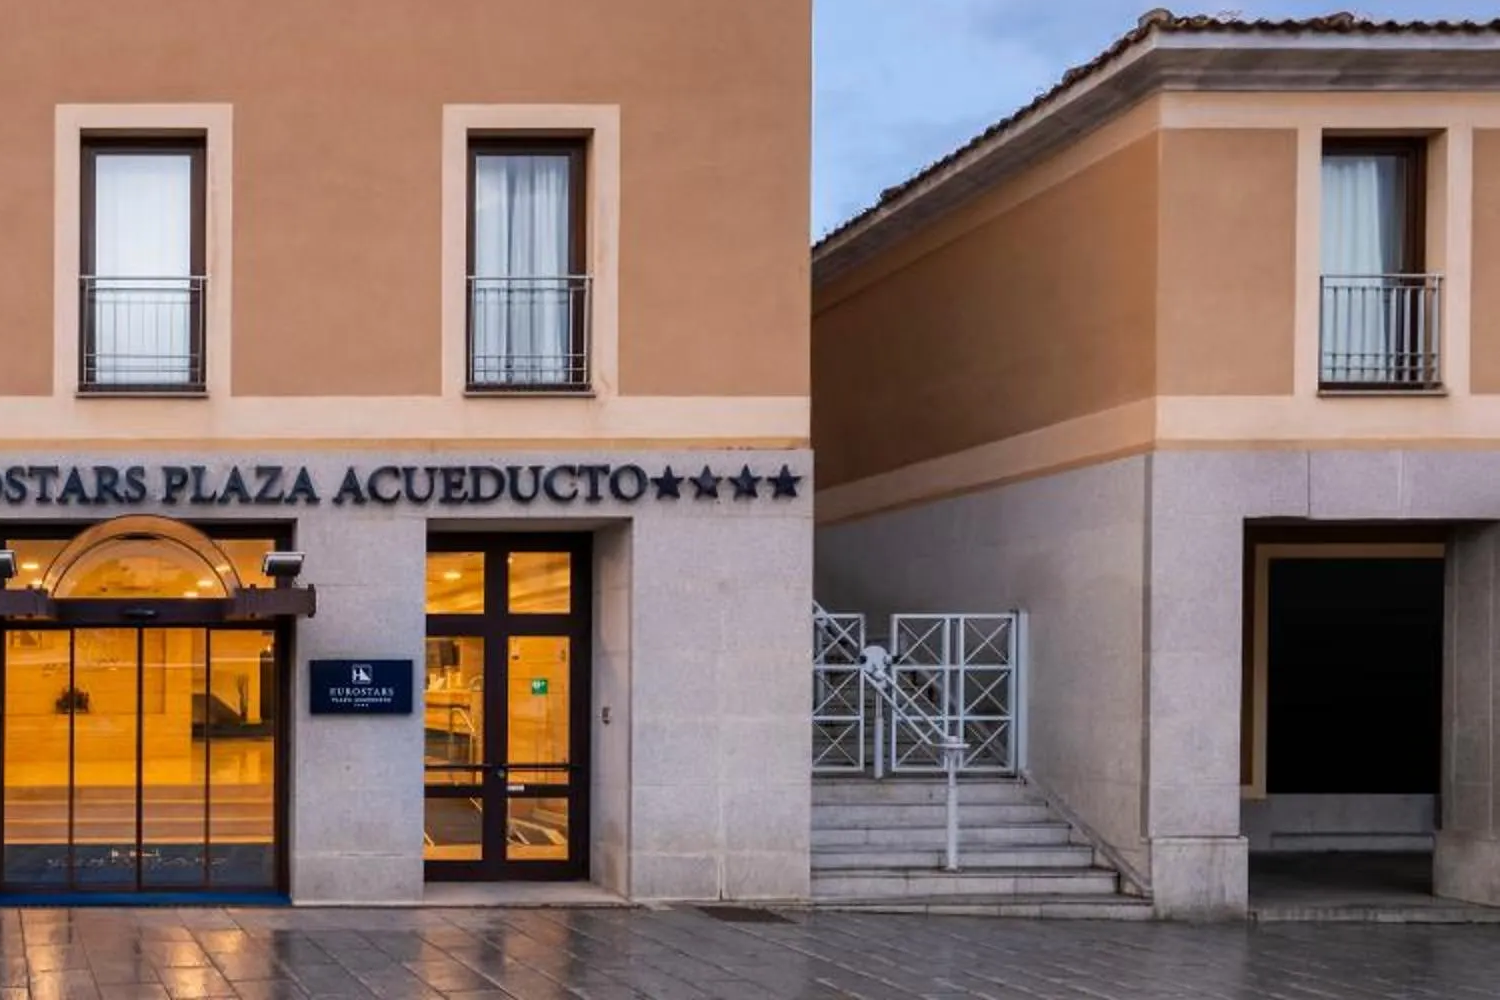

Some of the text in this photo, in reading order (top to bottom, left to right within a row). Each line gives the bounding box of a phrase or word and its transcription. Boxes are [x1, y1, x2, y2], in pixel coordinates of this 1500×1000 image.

[161, 465, 321, 505] PLAZA
[332, 465, 648, 504] ACUEDUCTO
[329, 687, 394, 697] EUROSTARS
